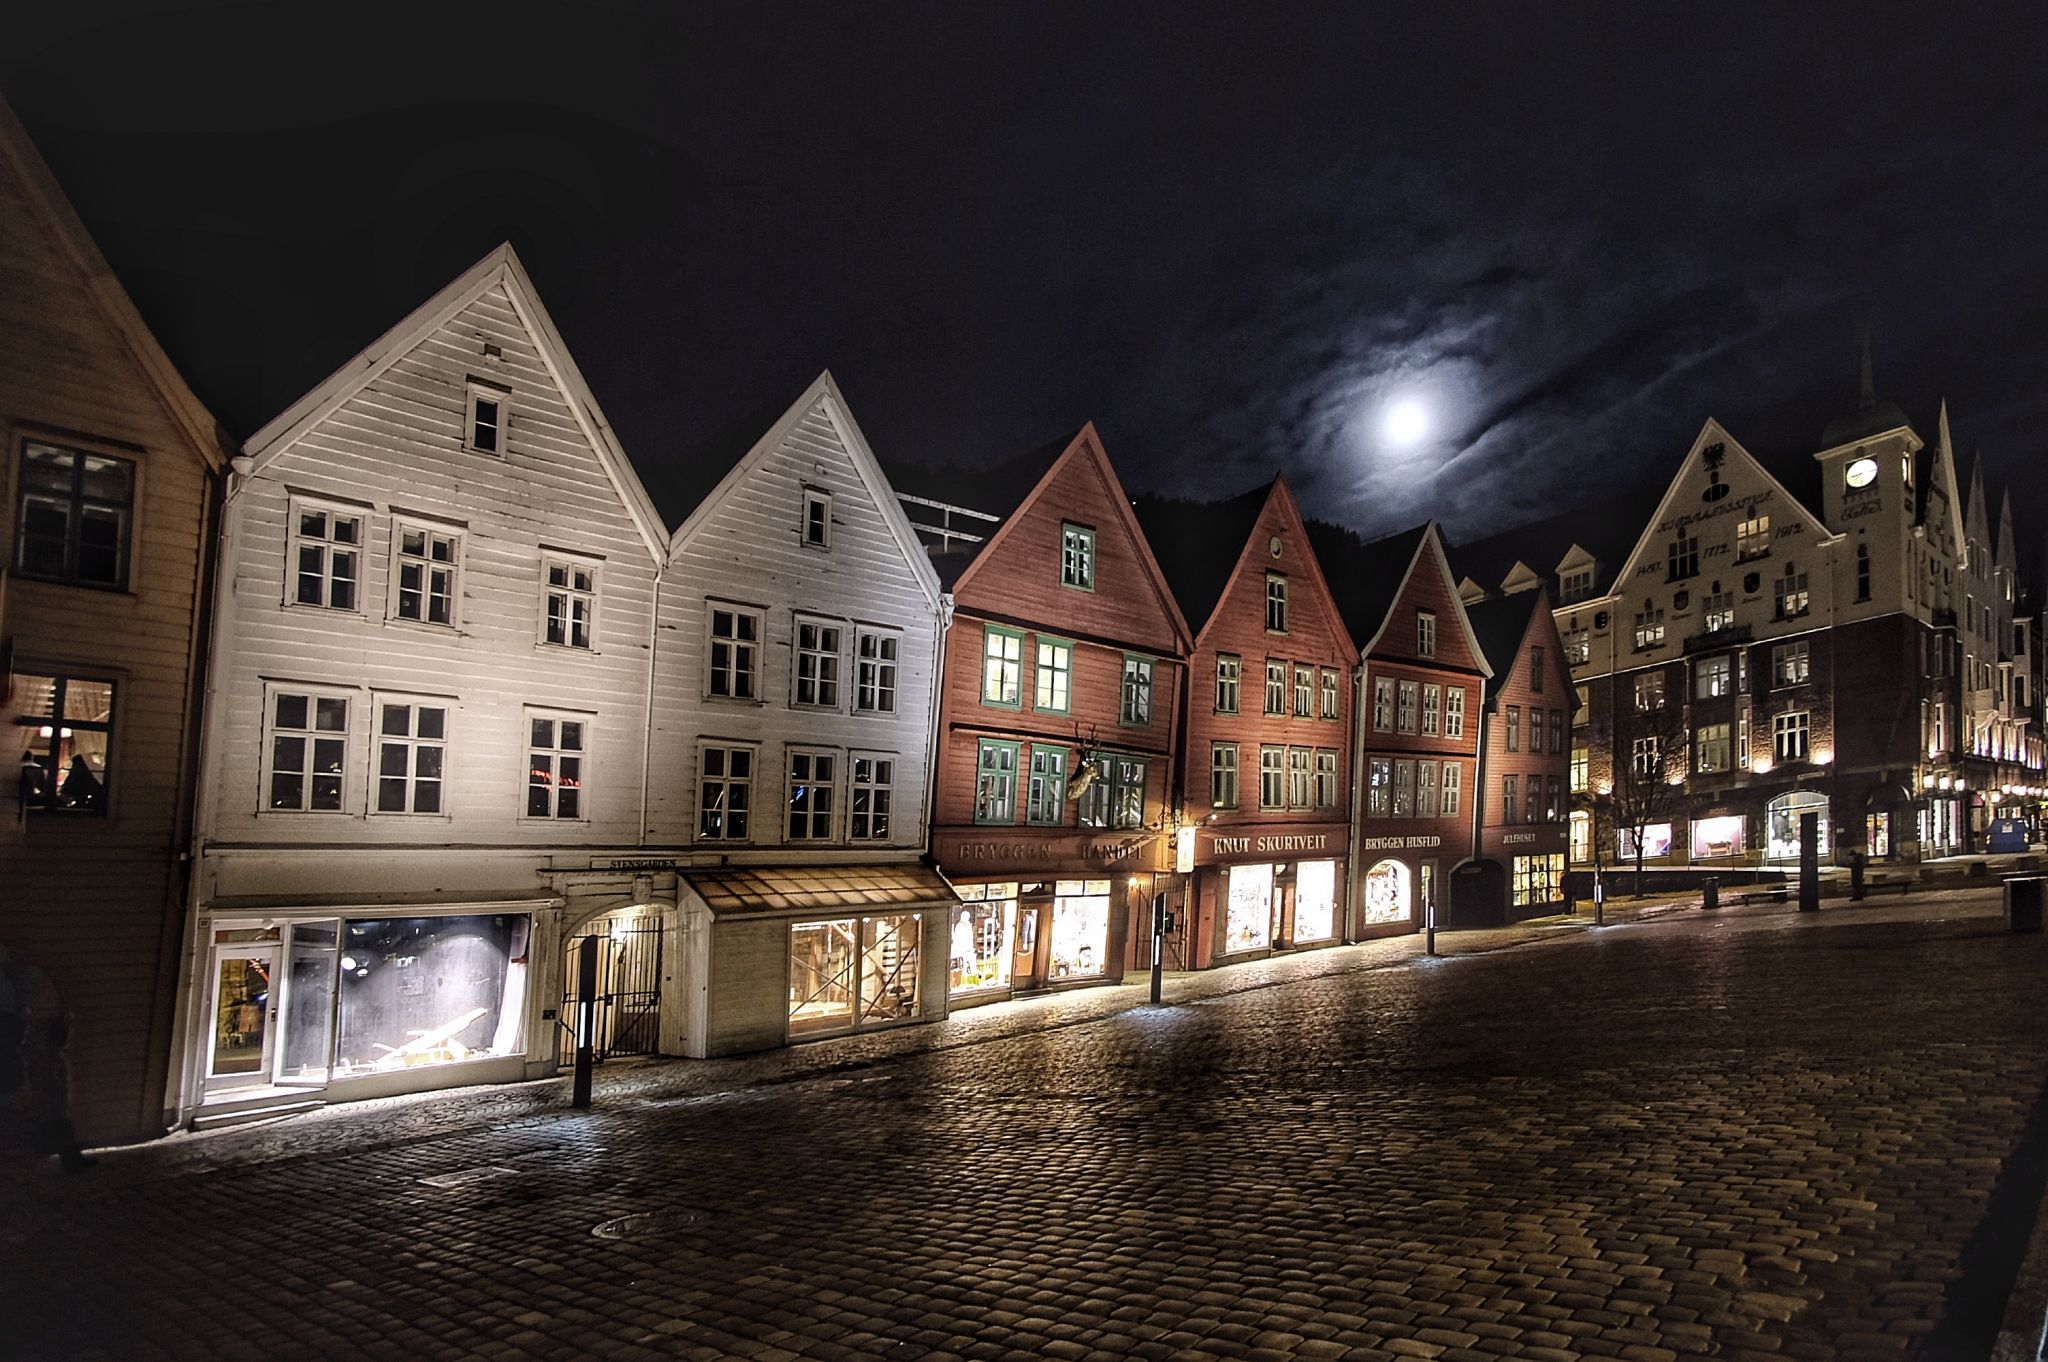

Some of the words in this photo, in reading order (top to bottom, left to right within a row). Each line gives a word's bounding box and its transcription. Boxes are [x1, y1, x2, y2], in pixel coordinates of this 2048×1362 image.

[959, 843, 1051, 861] BRYGGEN
[1214, 837, 1250, 854] KNUT
[1257, 834, 1327, 852] SKURTVEIT
[1365, 837, 1404, 850] BRYGGEN
[1406, 836, 1441, 848] HUSFLID
